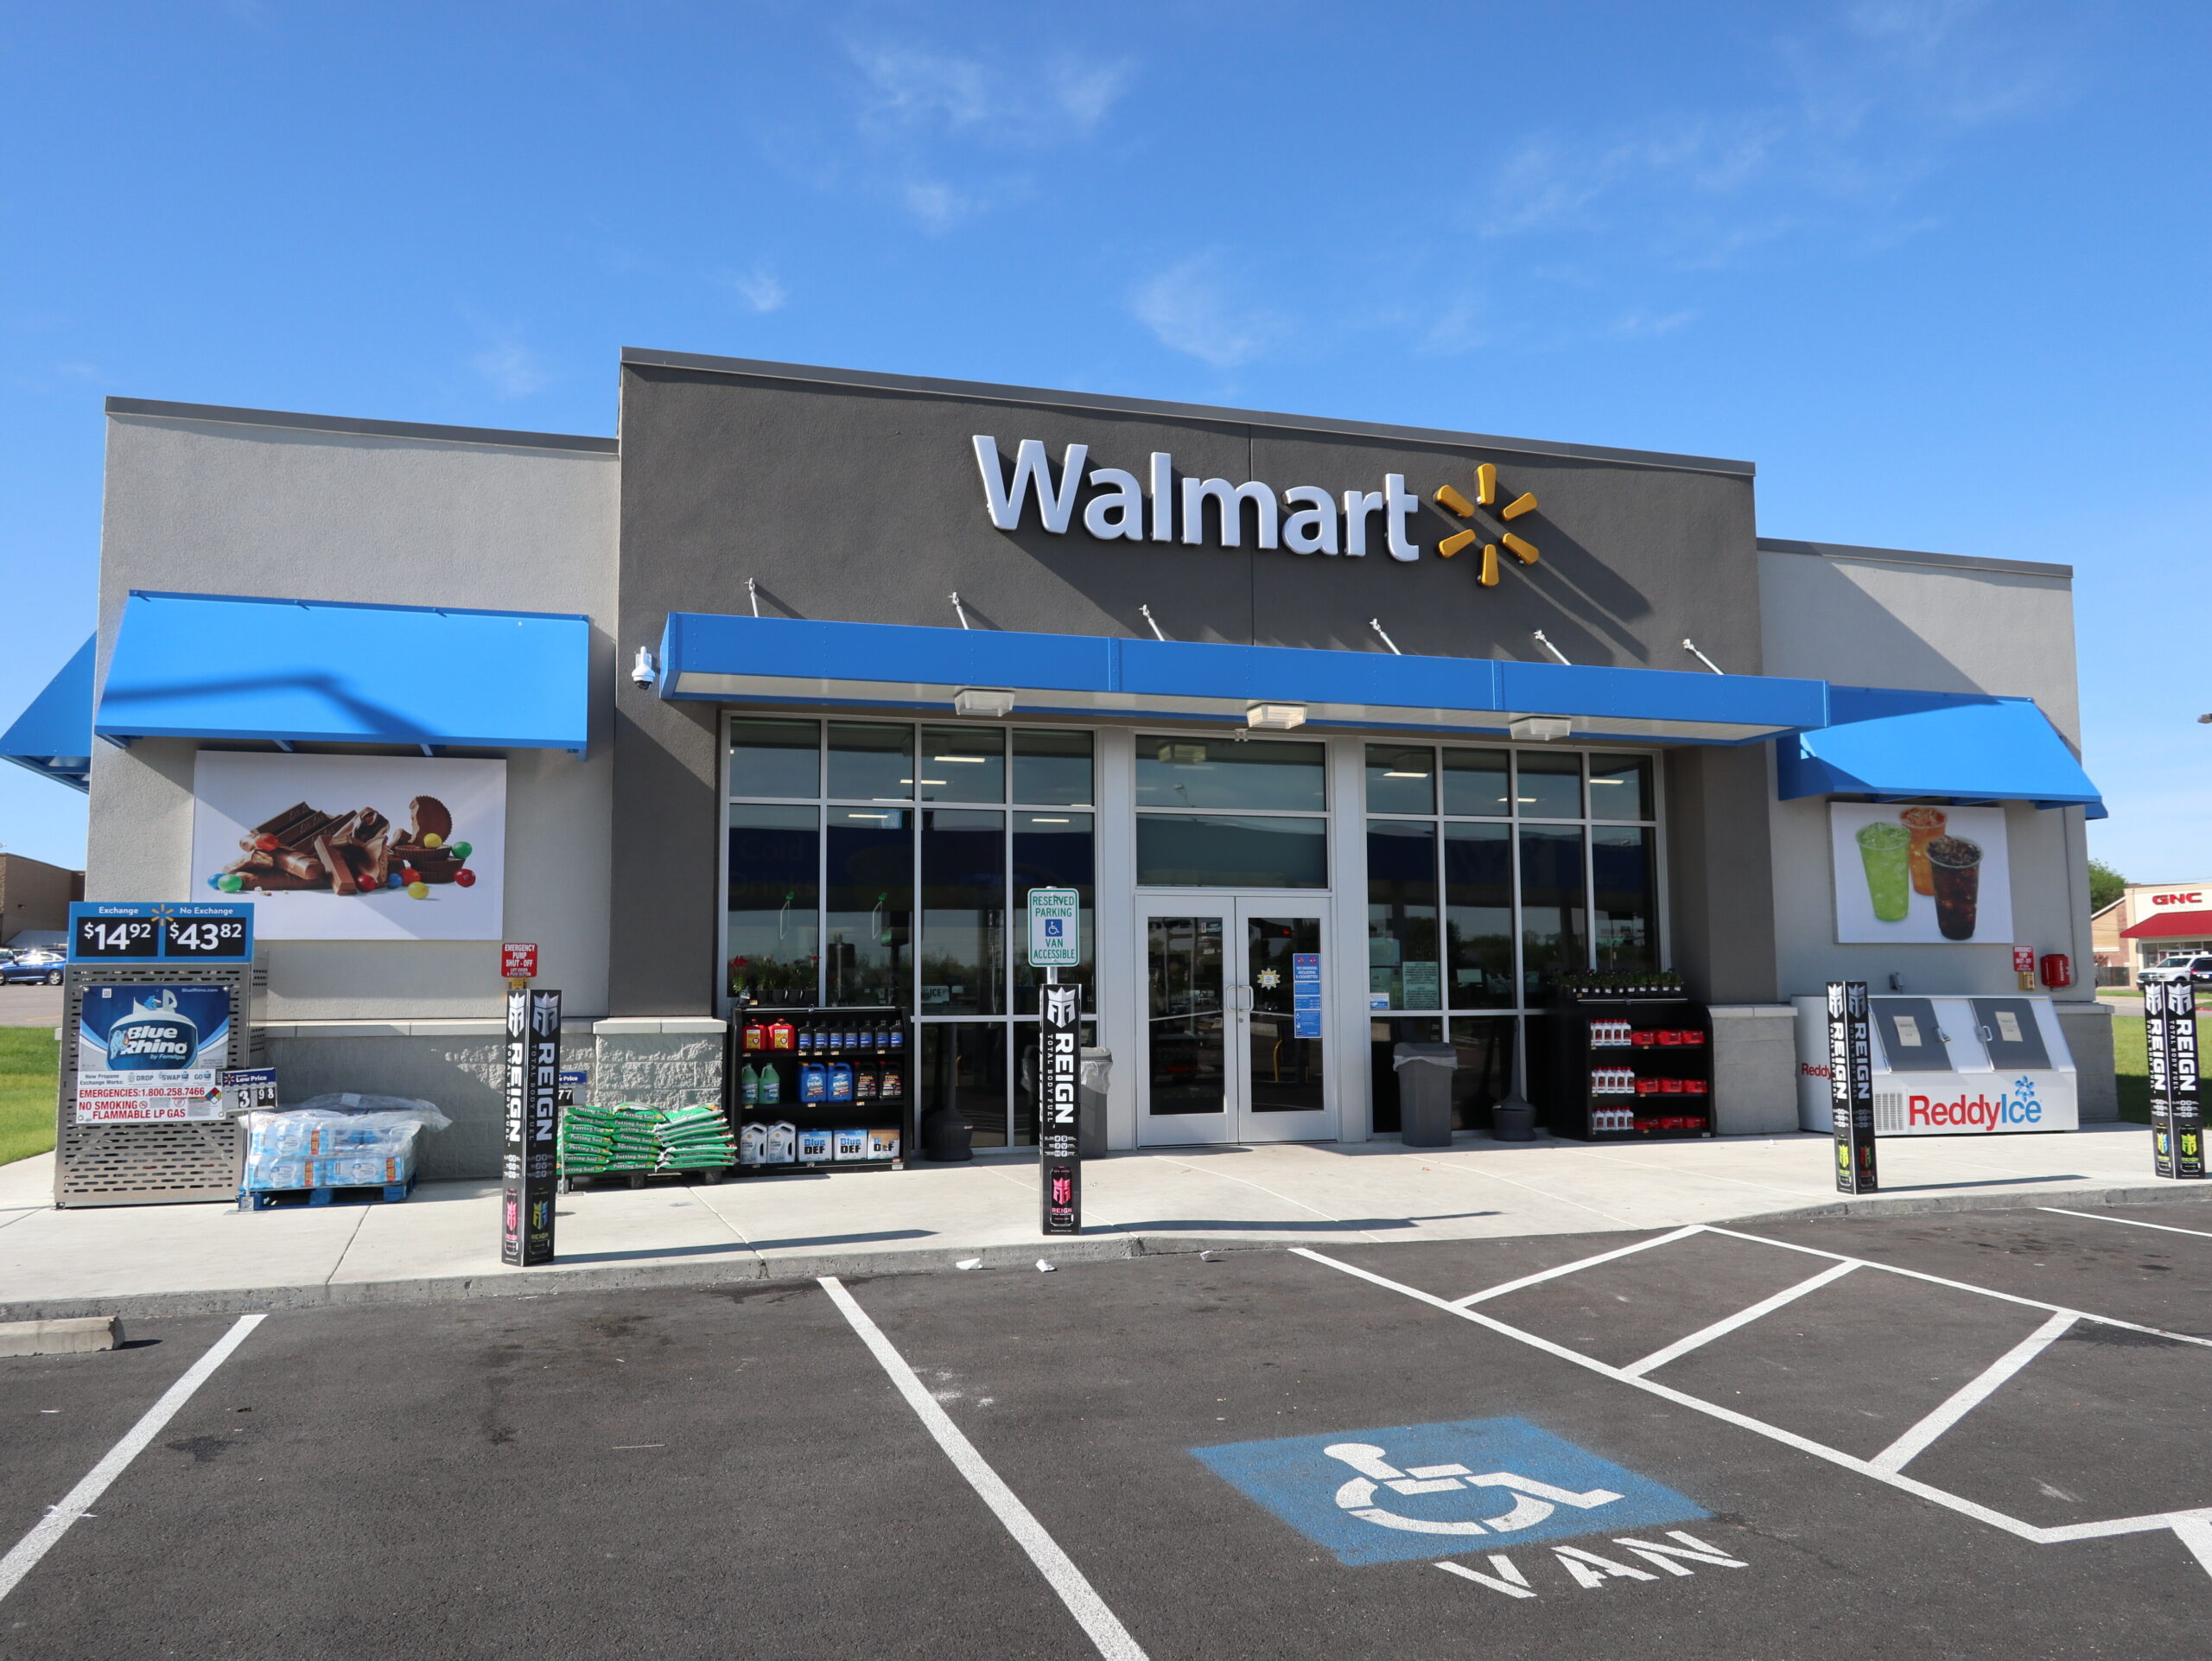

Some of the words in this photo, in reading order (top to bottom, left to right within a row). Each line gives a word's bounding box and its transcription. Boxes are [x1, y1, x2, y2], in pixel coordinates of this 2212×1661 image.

[972, 433, 1420, 562] Walmart
[1033, 896, 1074, 906] RESERVED
[2152, 892, 2202, 906] GNC
[99, 907, 139, 915] Exchange
[1035, 907, 1072, 918] PARKING
[1046, 939, 1063, 948] VAN
[1033, 949, 1075, 959] ACCESSIBLE
[127, 1025, 178, 1039] Blue
[120, 1039, 188, 1055] Rhino
[2151, 1019, 2166, 1090] REIGN
[2177, 1019, 2196, 1091] REIGN
[1833, 1022, 1847, 1099] REIGN
[1854, 1022, 1870, 1099] REIGN
[1055, 1033, 1074, 1123] REIGN
[238, 1091, 250, 1108] 3
[510, 1042, 523, 1142] REIGN
[536, 1042, 555, 1142] REIGN
[79, 1101, 92, 1111] NO
[94, 1100, 137, 1110] SMOKING
[92, 1110, 150, 1119] FLAMMABLE
[154, 1109, 165, 1118] LP
[167, 1108, 186, 1117] GAS
[1909, 1093, 2042, 1131] ReddyIce
[804, 1145, 825, 1155] DEF
[841, 1144, 861, 1154] DEF
[1433, 1531, 1749, 1598] VAN
